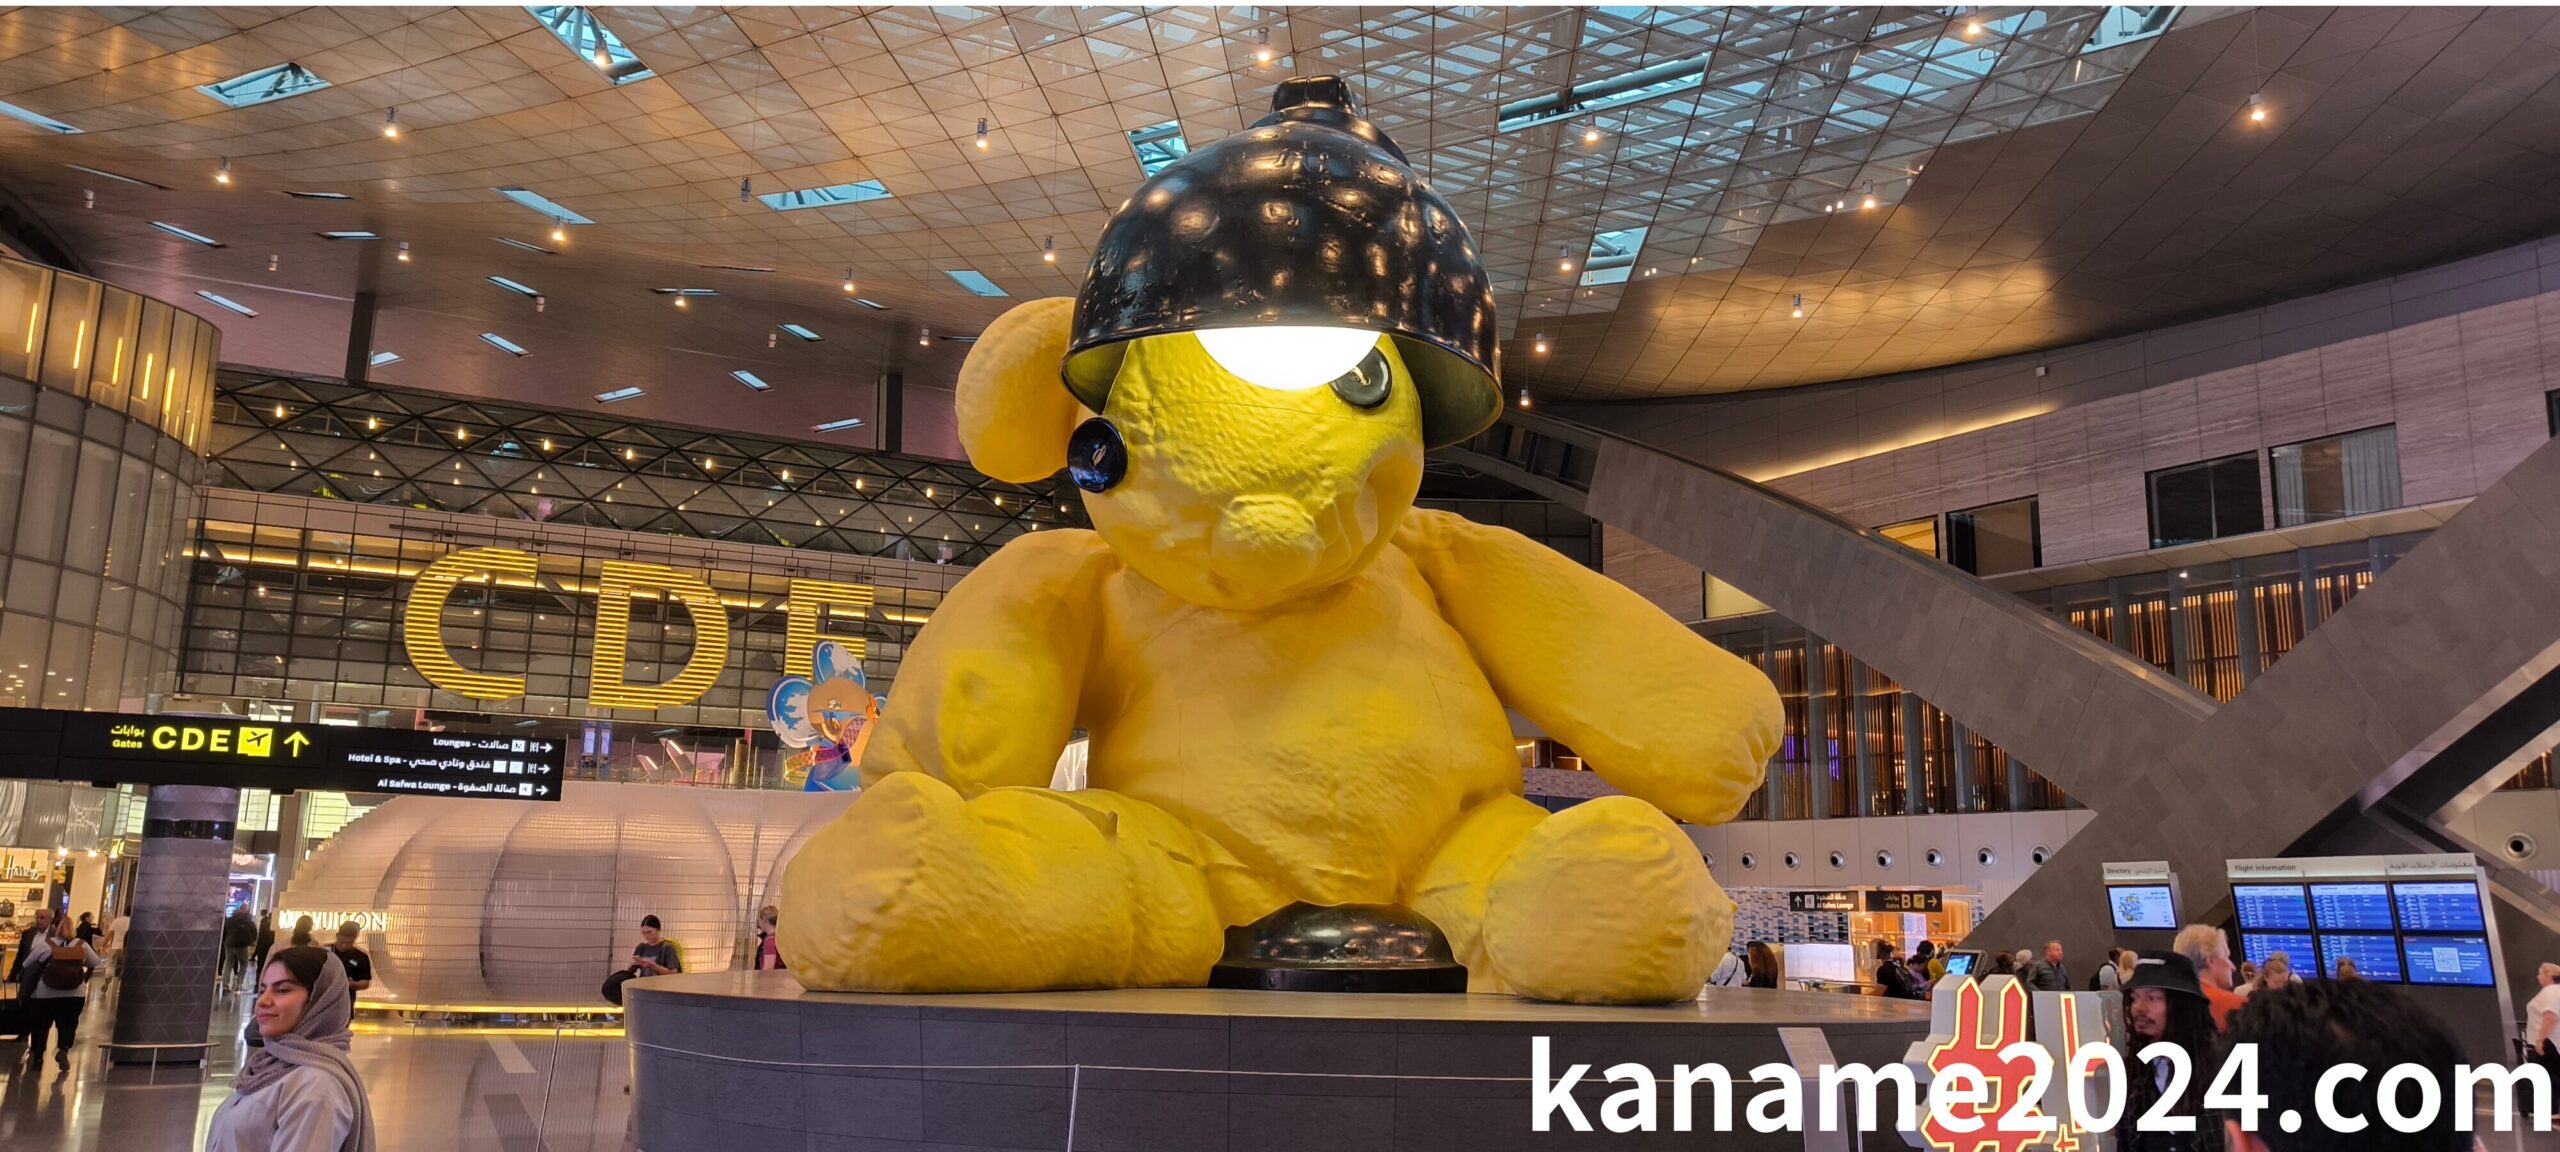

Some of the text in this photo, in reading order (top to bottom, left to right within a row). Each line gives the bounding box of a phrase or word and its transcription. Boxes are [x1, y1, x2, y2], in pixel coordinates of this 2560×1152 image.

[110, 724, 145, 738] بوابات
[112, 739, 143, 749] Gates
[152, 726, 231, 752] CDE
[432, 738, 471, 749] Lounges
[478, 740, 509, 750] صالات
[348, 753, 374, 763] Hotel
[375, 755, 383, 763] &
[384, 755, 401, 765] Spa
[466, 763, 491, 771] فندق
[377, 779, 388, 788] Al
[389, 779, 417, 789] Safwa
[418, 781, 451, 792] Lounge
[458, 782, 516, 793] صالة الصفوة
[2234, 864, 2254, 873] Flight
[1901, 894, 1911, 909] B
